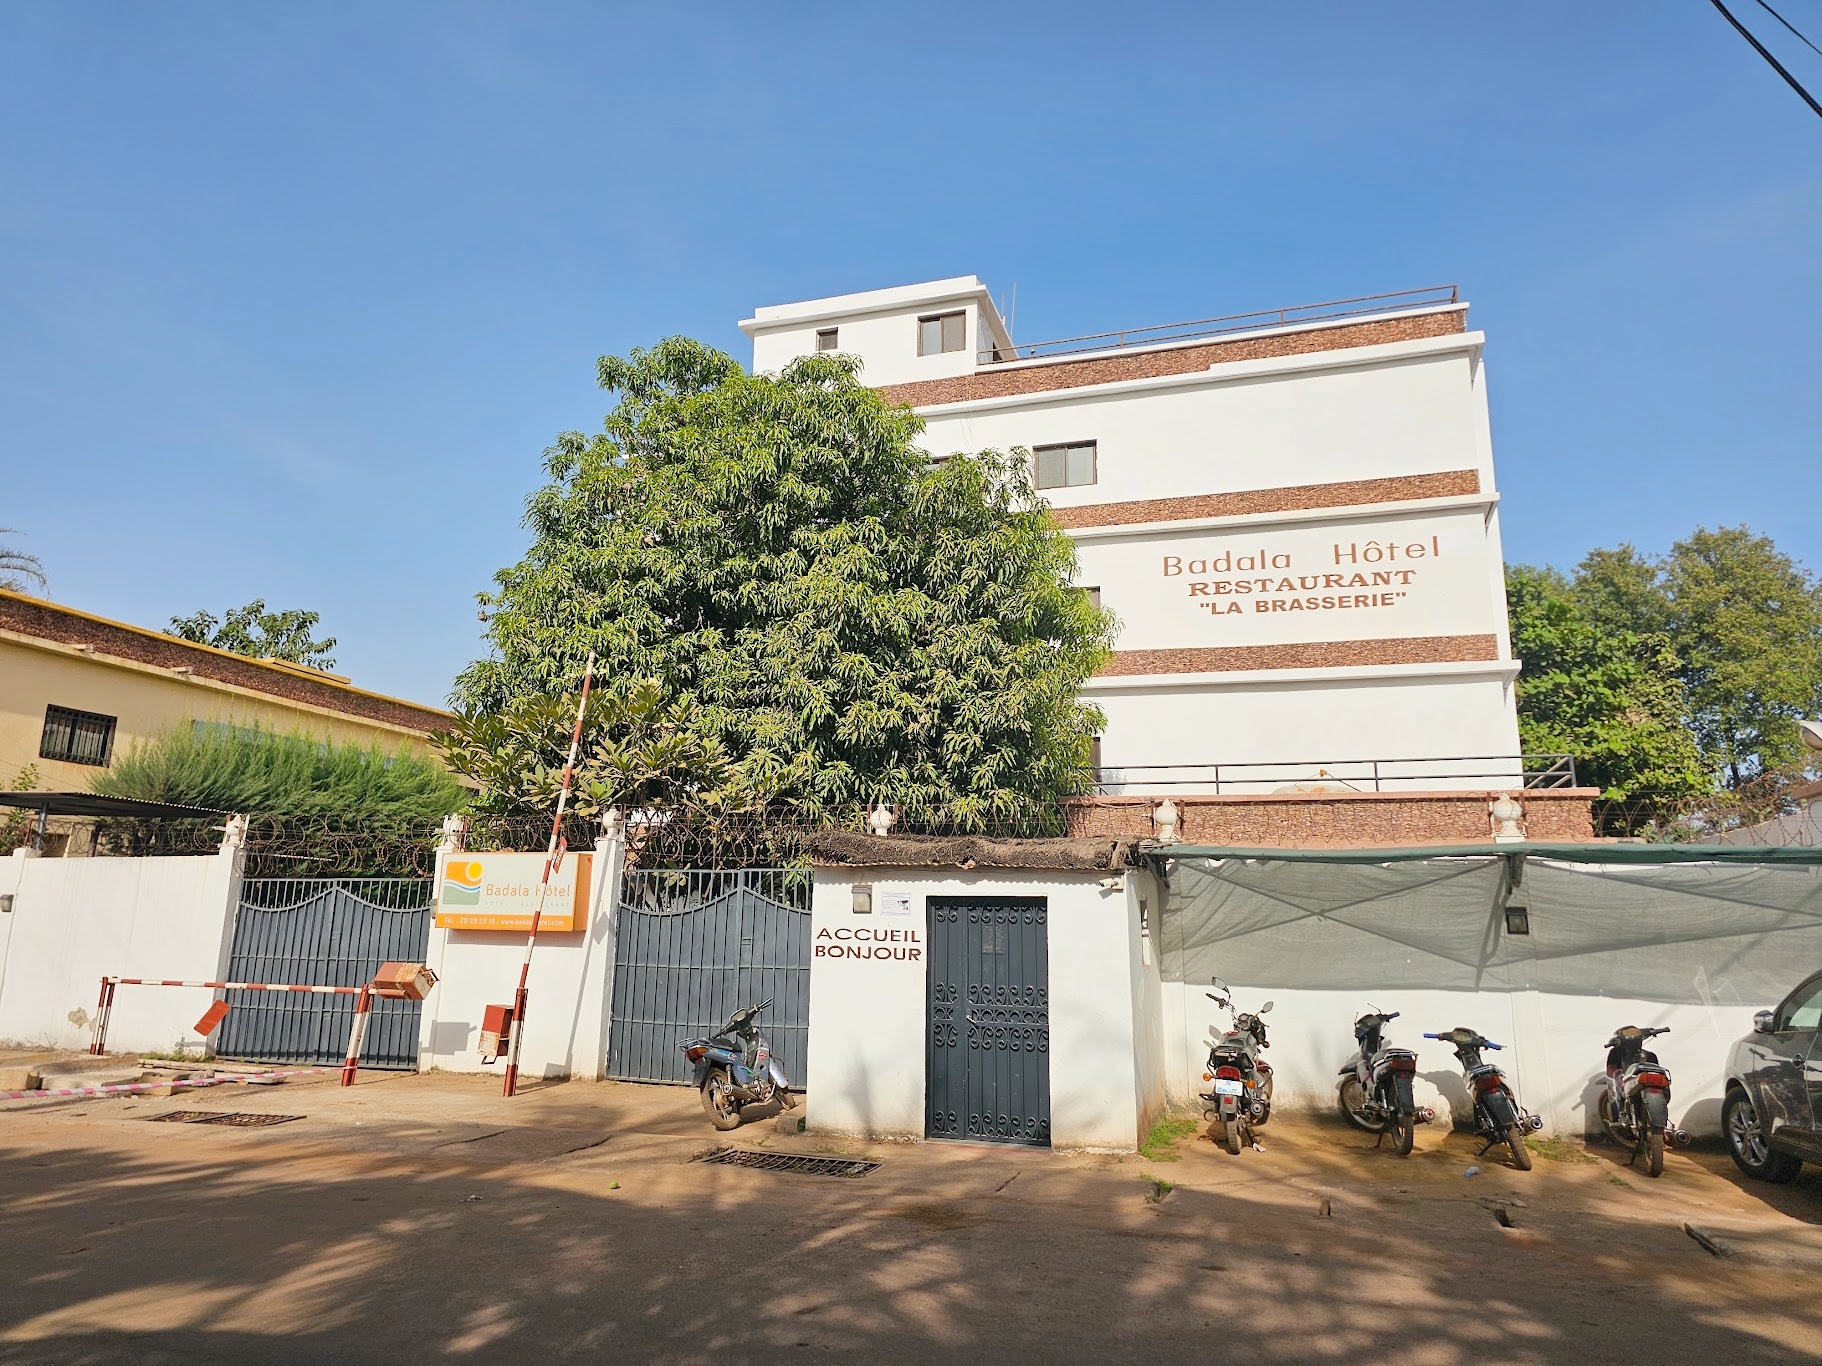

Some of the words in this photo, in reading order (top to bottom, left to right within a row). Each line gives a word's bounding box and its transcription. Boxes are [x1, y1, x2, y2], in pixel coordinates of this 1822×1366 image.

[1163, 549, 1291, 577] Badala
[1334, 535, 1439, 565] Hôtel
[1188, 569, 1417, 597] RESTAURANT
[1199, 602, 1243, 615] "LA
[1255, 591, 1407, 613] BRASSERIE"
[486, 883, 529, 897] Badala
[816, 927, 921, 943] ACCUEIL
[815, 945, 922, 961] BONJOUR
